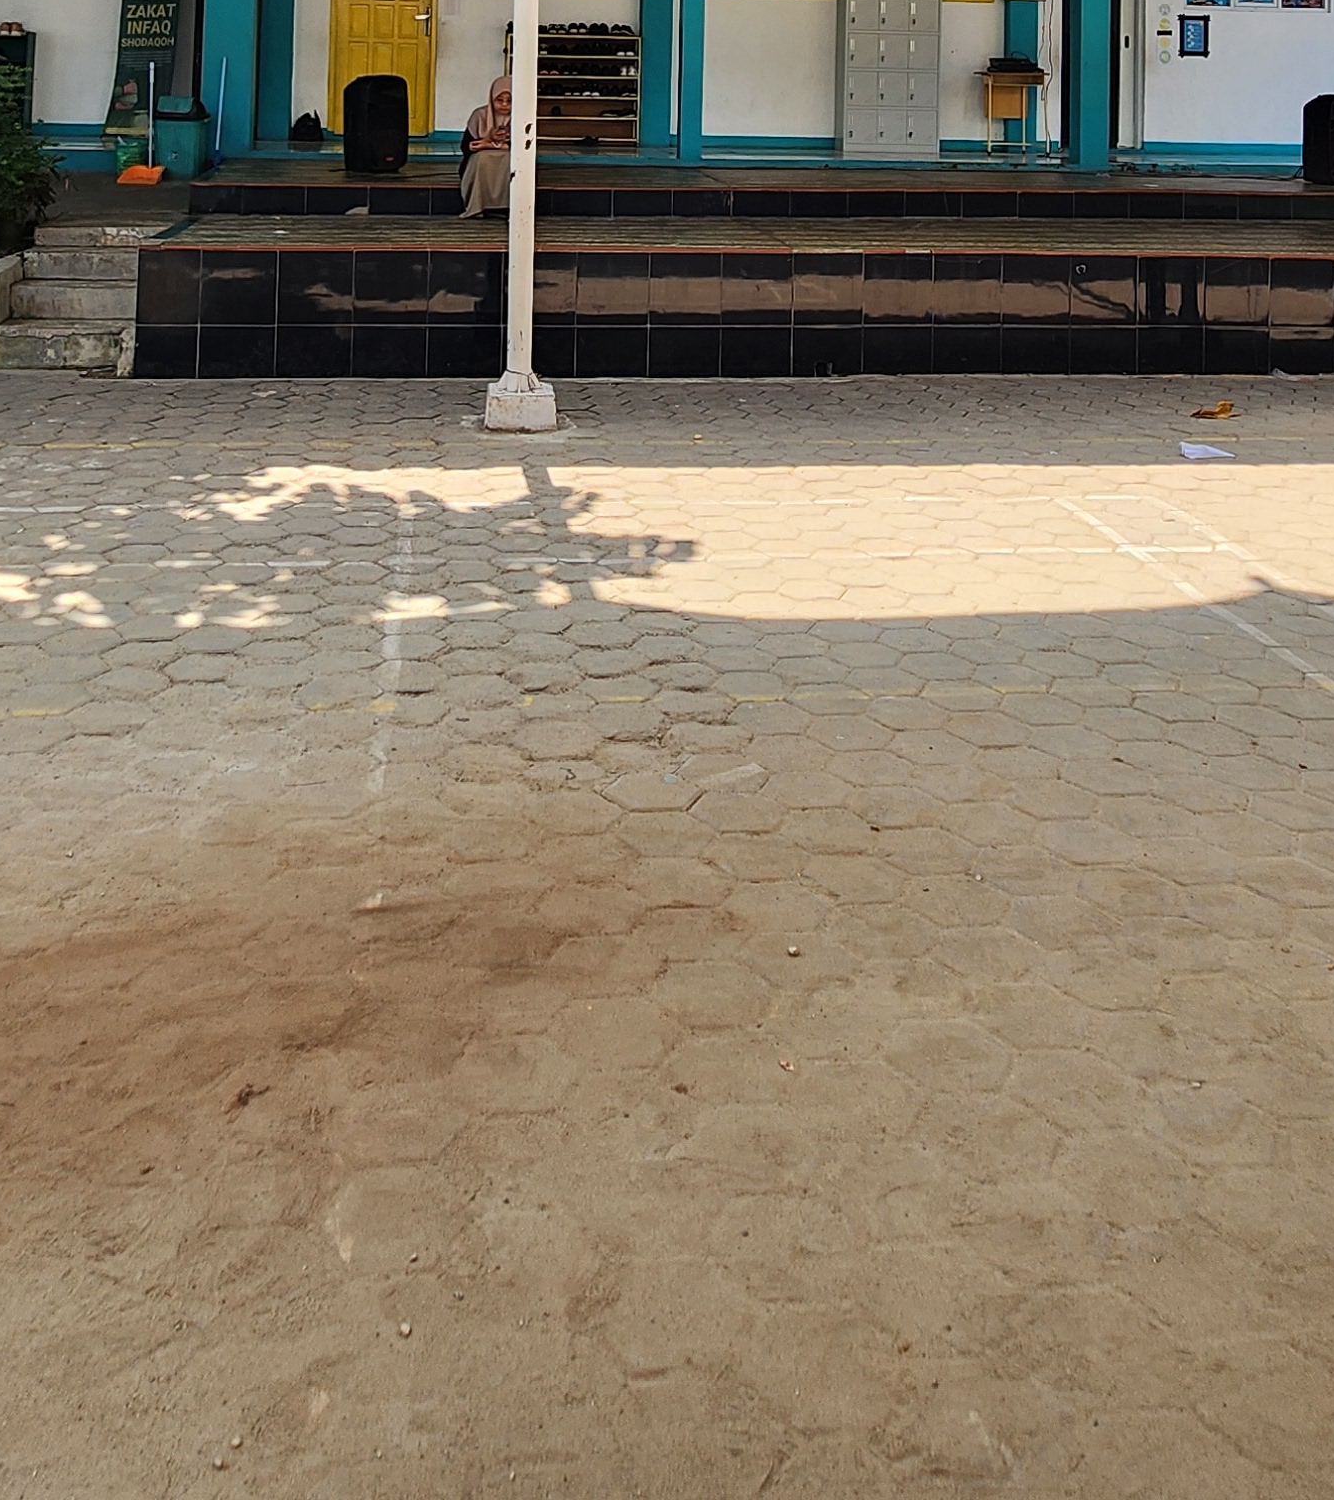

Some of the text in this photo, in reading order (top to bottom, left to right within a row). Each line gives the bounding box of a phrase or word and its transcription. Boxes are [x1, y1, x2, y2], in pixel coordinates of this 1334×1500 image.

[126, 3, 176, 18] ZAKAT
[127, 20, 171, 35] INFAQ
[120, 37, 175, 47] SHODAQOH
